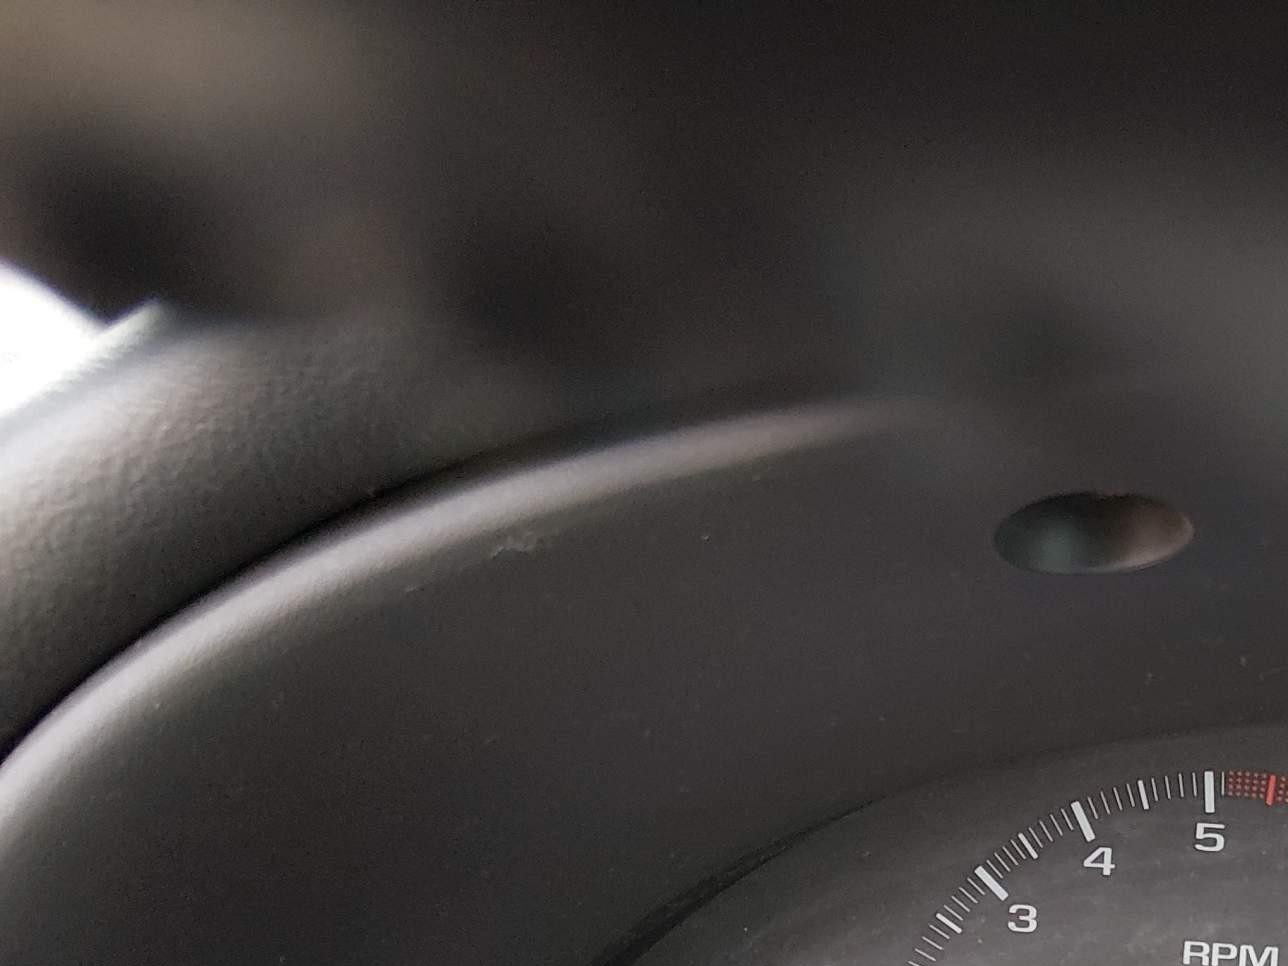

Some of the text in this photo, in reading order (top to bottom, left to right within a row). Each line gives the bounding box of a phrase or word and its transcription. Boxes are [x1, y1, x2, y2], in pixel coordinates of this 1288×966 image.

[1195, 823, 1224, 851] 5
[1084, 848, 1115, 875] 4
[1008, 905, 1037, 932] 3
